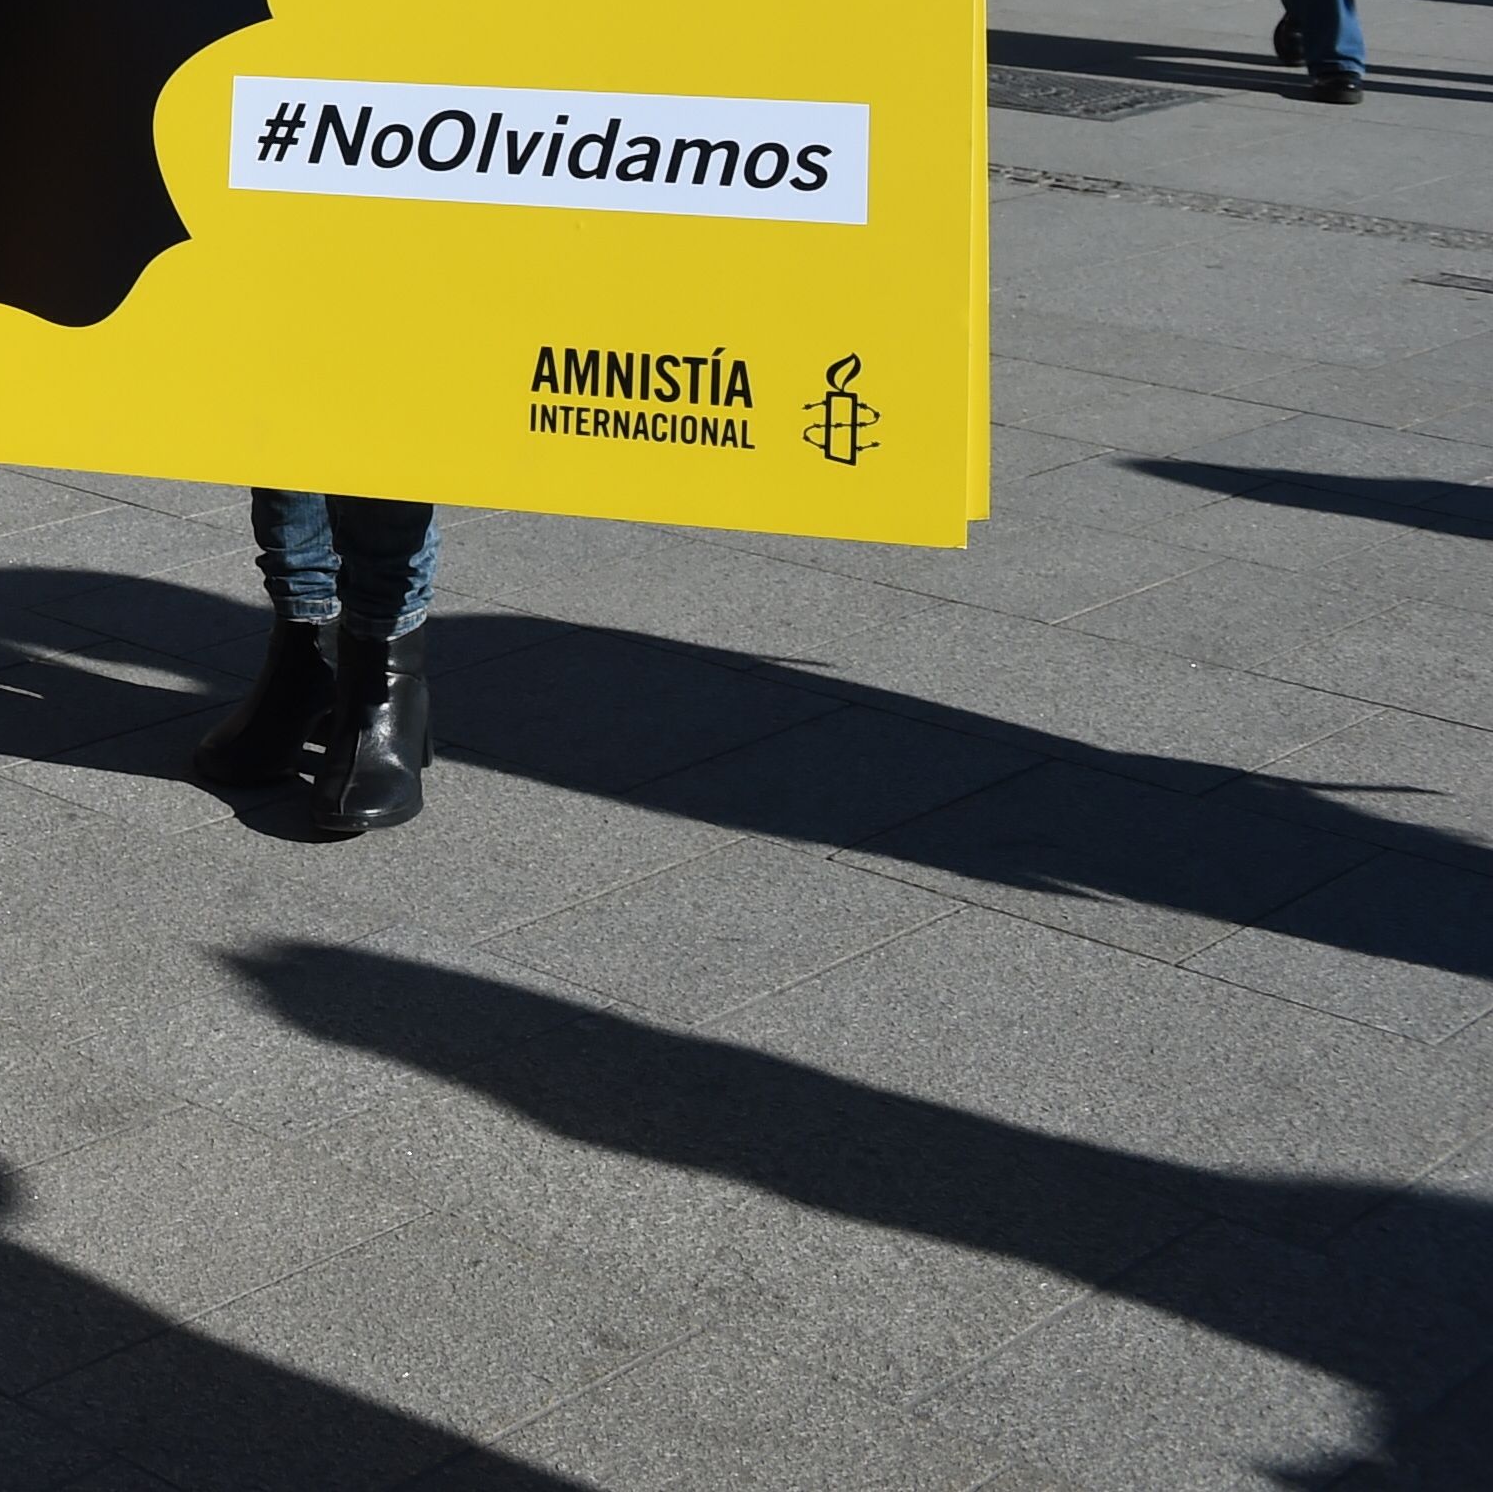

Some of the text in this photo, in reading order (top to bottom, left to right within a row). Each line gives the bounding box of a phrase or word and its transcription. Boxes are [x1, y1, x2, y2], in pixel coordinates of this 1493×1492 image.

[257, 102, 833, 192] #NoOlvidamos
[531, 346, 753, 409] AMNISTÍA
[530, 403, 756, 450] INTERNACIONAL
